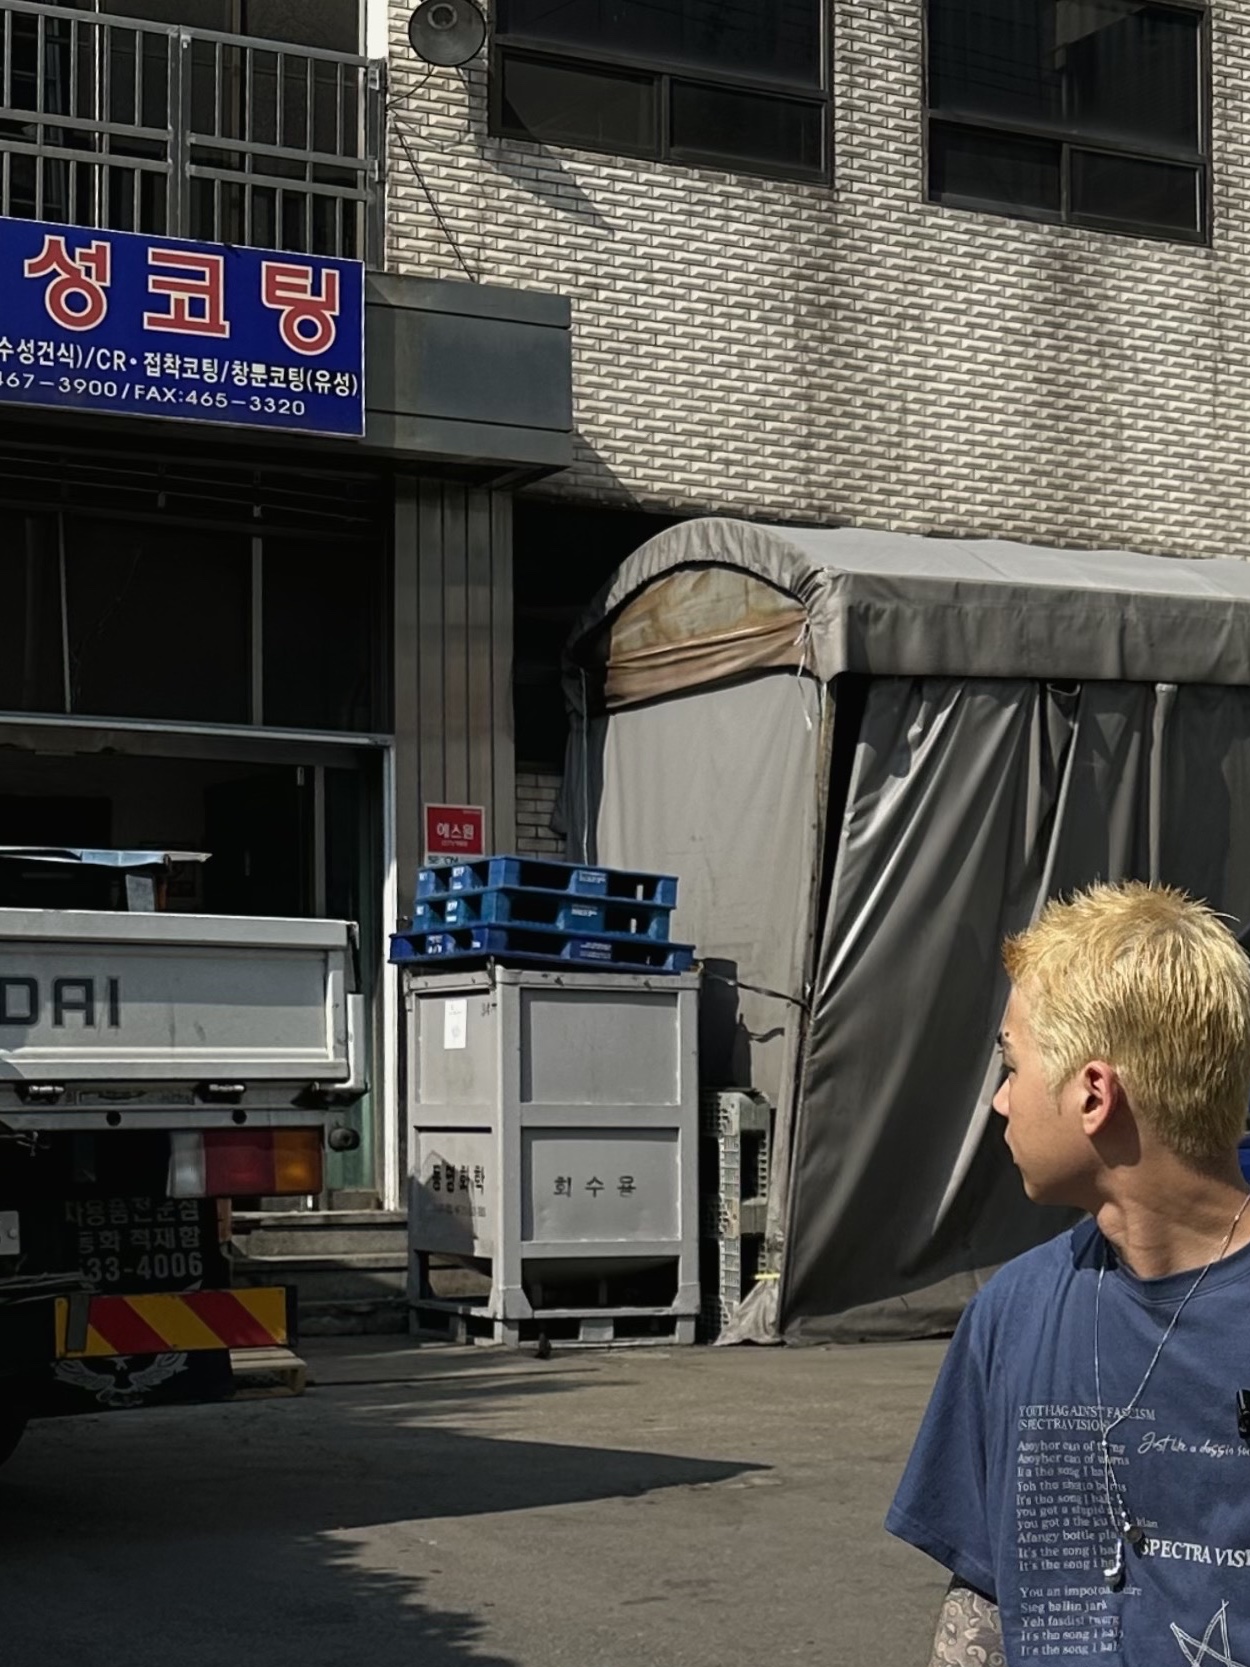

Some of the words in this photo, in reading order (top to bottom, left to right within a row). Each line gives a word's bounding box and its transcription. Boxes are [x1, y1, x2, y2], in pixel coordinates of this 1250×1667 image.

[436, 822, 474, 840] 에스원
[0, 977, 120, 1028] DAI
[130, 1225, 201, 1251] 적재함
[80, 1251, 203, 1284] 33-4006
[1083, 1440, 1094, 1452] of
[1084, 1453, 1095, 1464] of
[1141, 1538, 1212, 1565] SPECTRA
[1020, 1586, 1043, 1598] You
